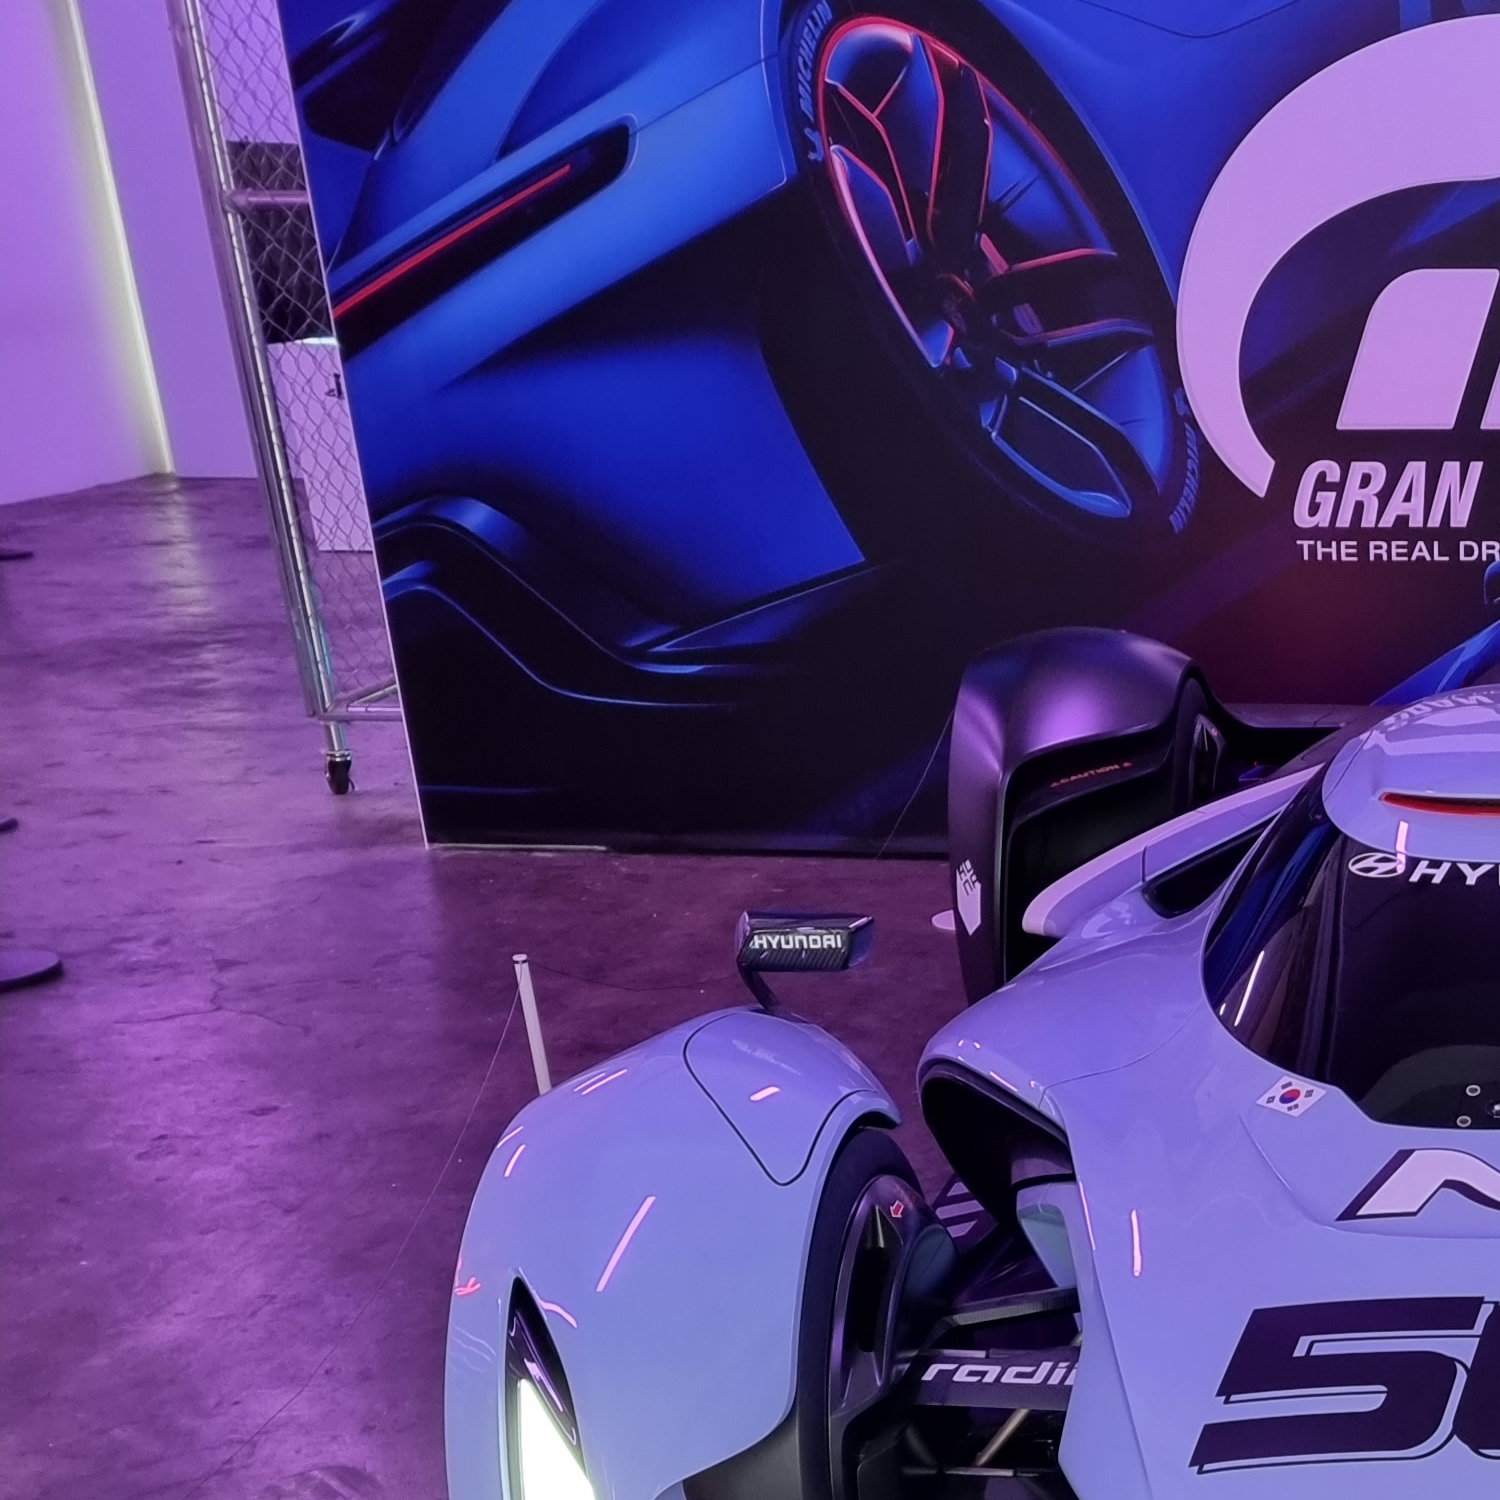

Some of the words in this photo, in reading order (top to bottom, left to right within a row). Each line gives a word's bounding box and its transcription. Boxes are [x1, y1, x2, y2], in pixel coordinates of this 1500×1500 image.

[1292, 460, 1484, 530] GRAN
[1296, 539, 1359, 562] THE
[1368, 540, 1450, 562] REAL
[753, 934, 842, 949] HYUNDAI
